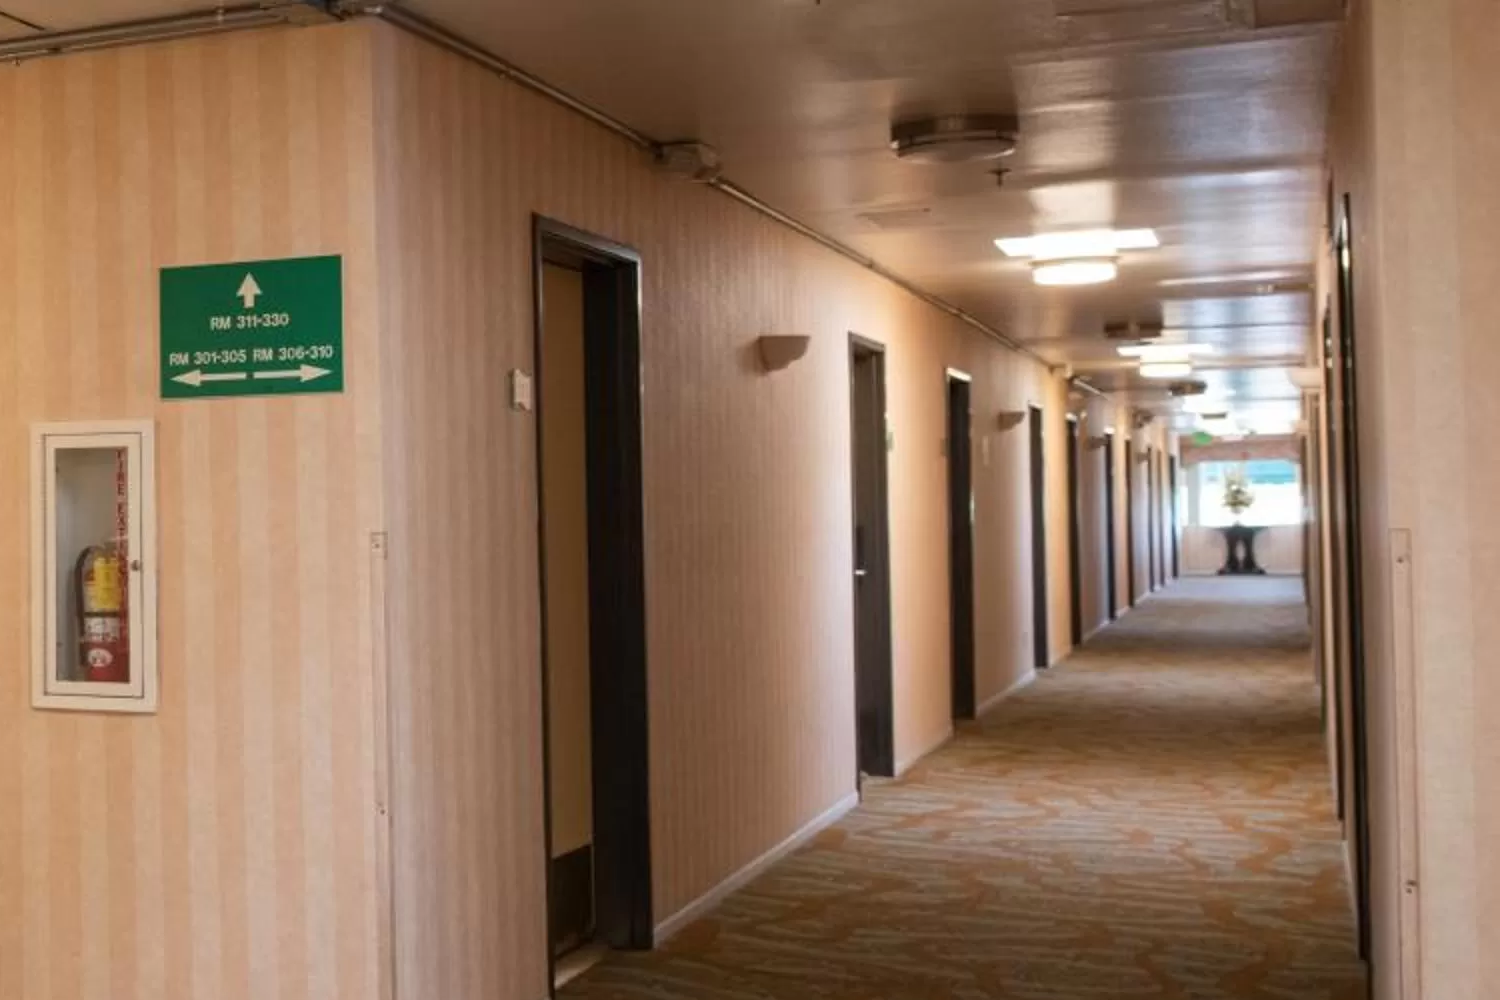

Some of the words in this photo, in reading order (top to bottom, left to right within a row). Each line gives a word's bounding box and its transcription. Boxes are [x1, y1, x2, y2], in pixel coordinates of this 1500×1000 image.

[210, 316, 231, 331] RM
[236, 313, 290, 329] 311-330
[169, 353, 189, 366] RM
[194, 349, 247, 365] 301-305
[253, 347, 273, 362] RM
[278, 344, 333, 360] 306-310
